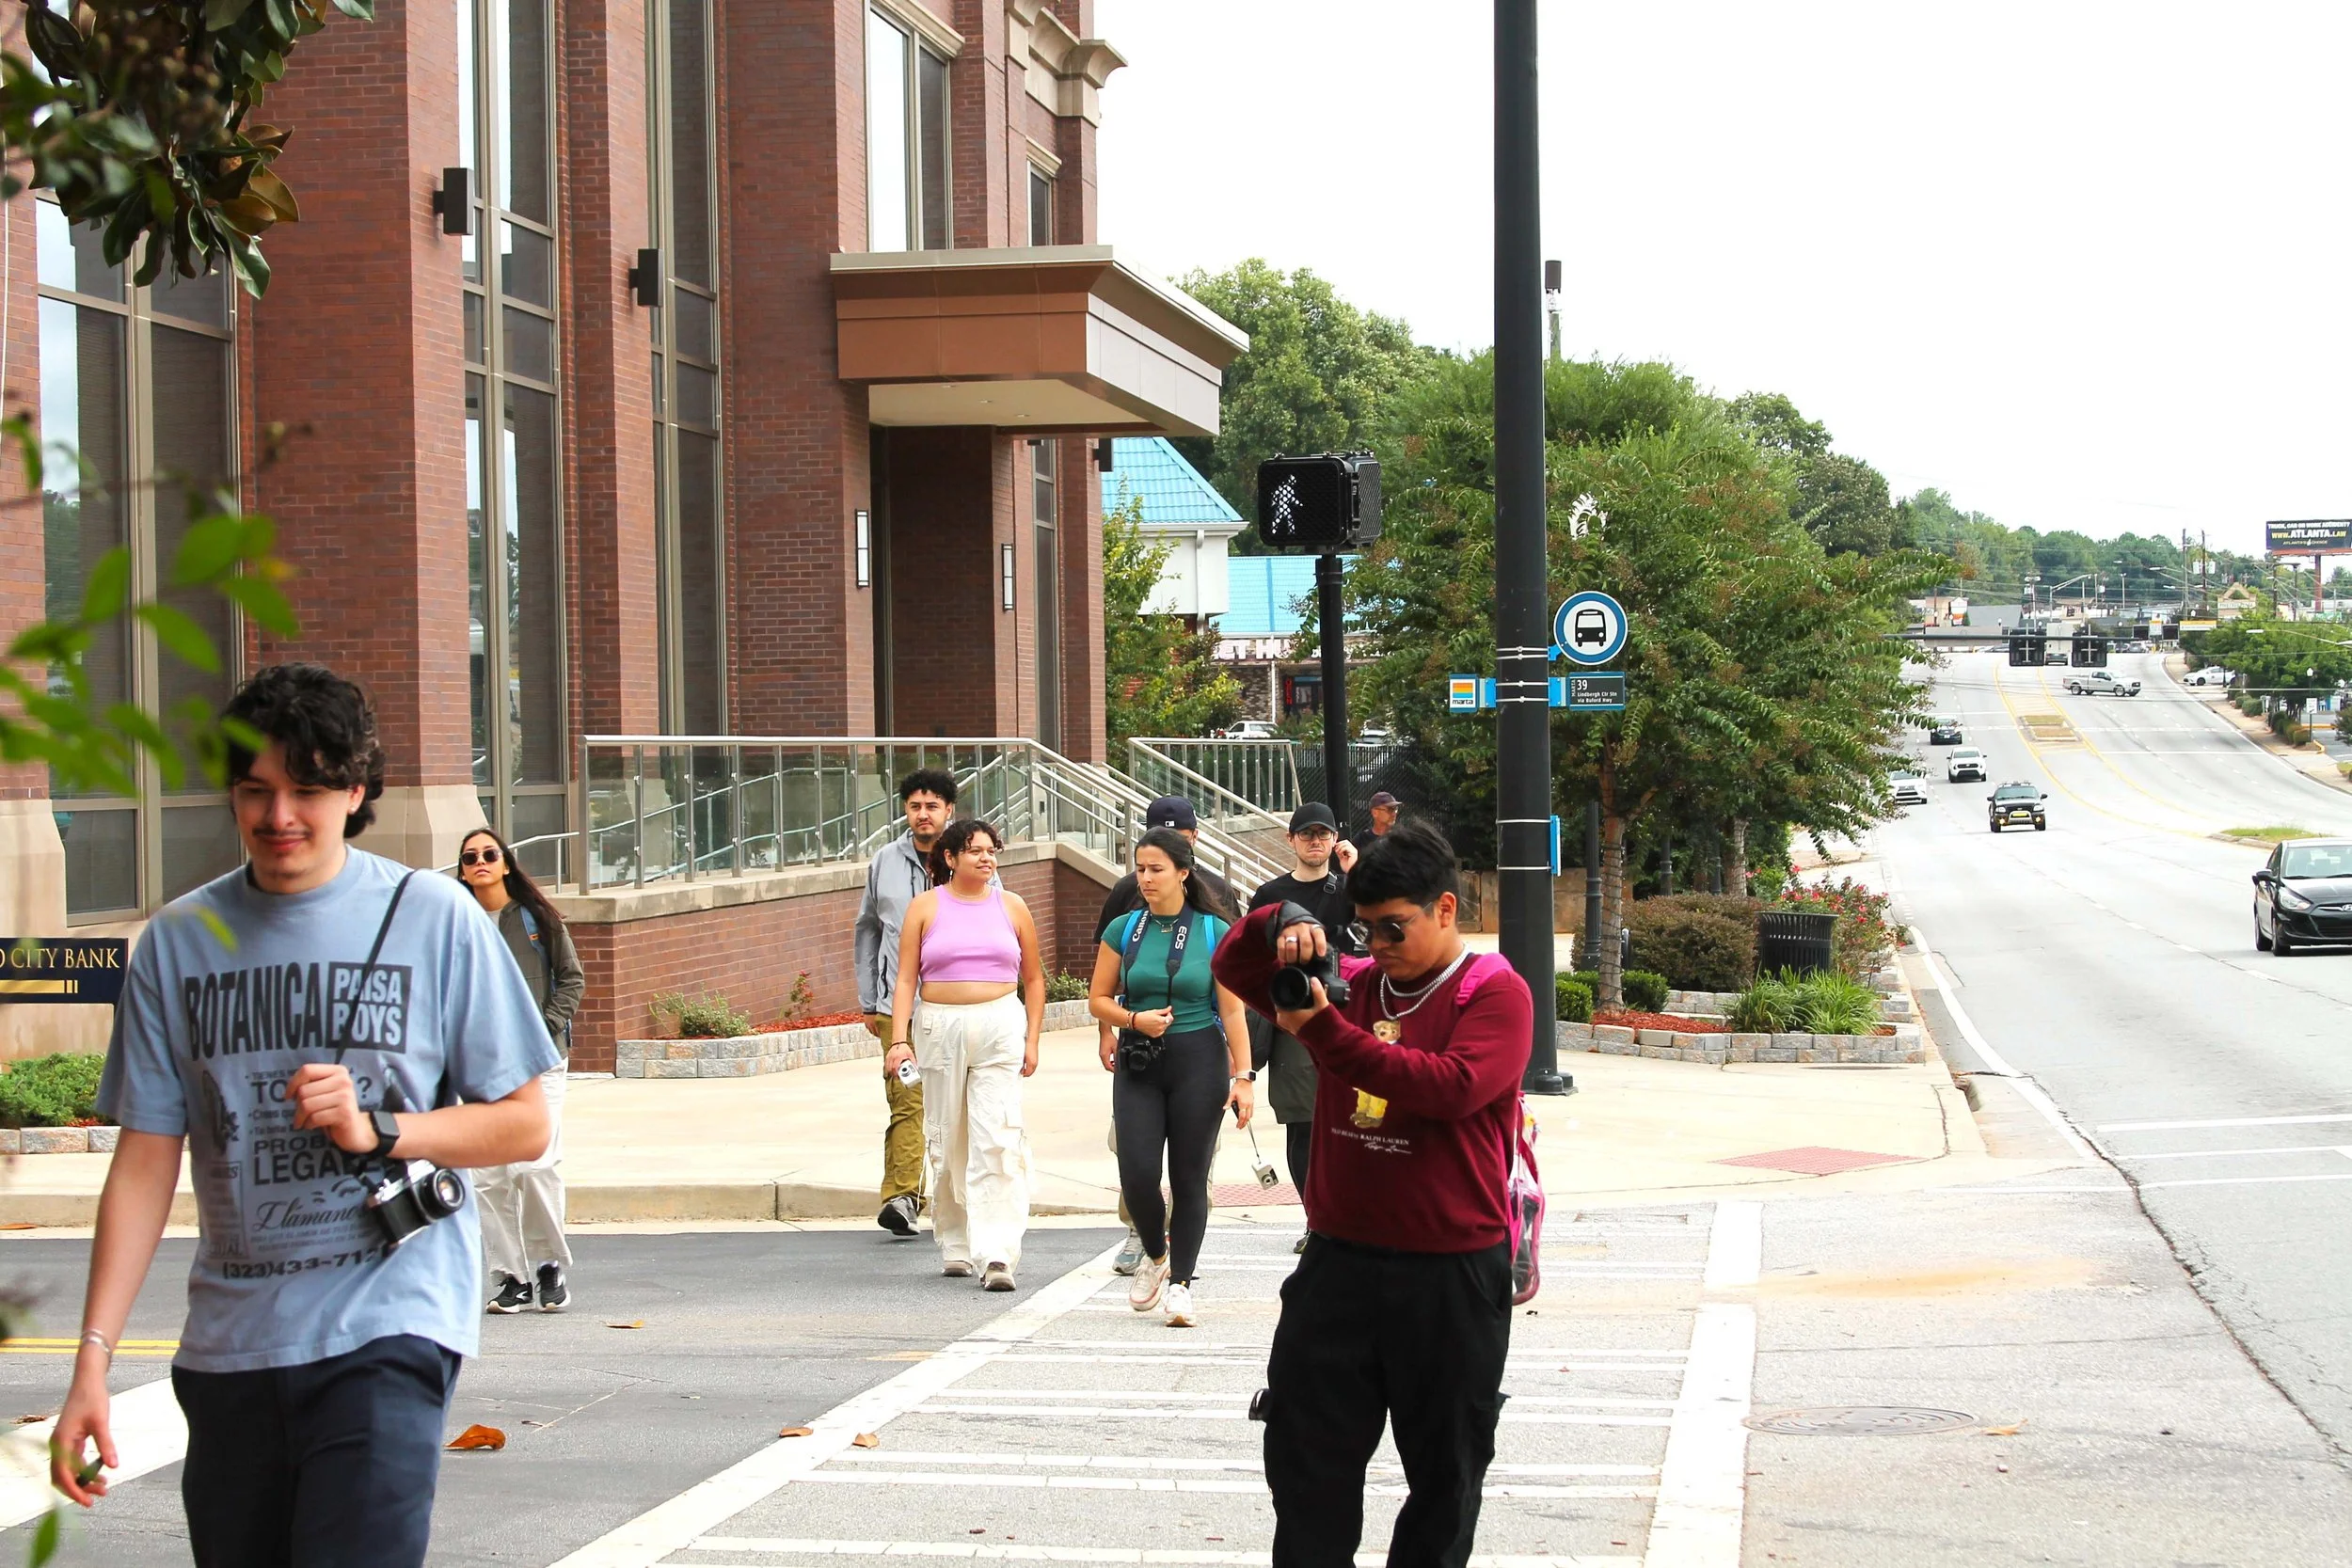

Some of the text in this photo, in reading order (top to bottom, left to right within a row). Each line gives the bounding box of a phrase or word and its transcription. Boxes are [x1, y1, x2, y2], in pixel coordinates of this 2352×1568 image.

[1576, 679, 1588, 690] 39
[1132, 910, 1150, 942] Canon
[1174, 925, 1188, 950] EOS
[10, 947, 59, 969] CITY
[64, 947, 120, 969] BANK
[333, 967, 403, 1006] PAISA
[184, 961, 324, 1062] BOTANICA
[331, 1002, 403, 1046] BOYS
[1360, 1133, 1382, 1142] RALPH
